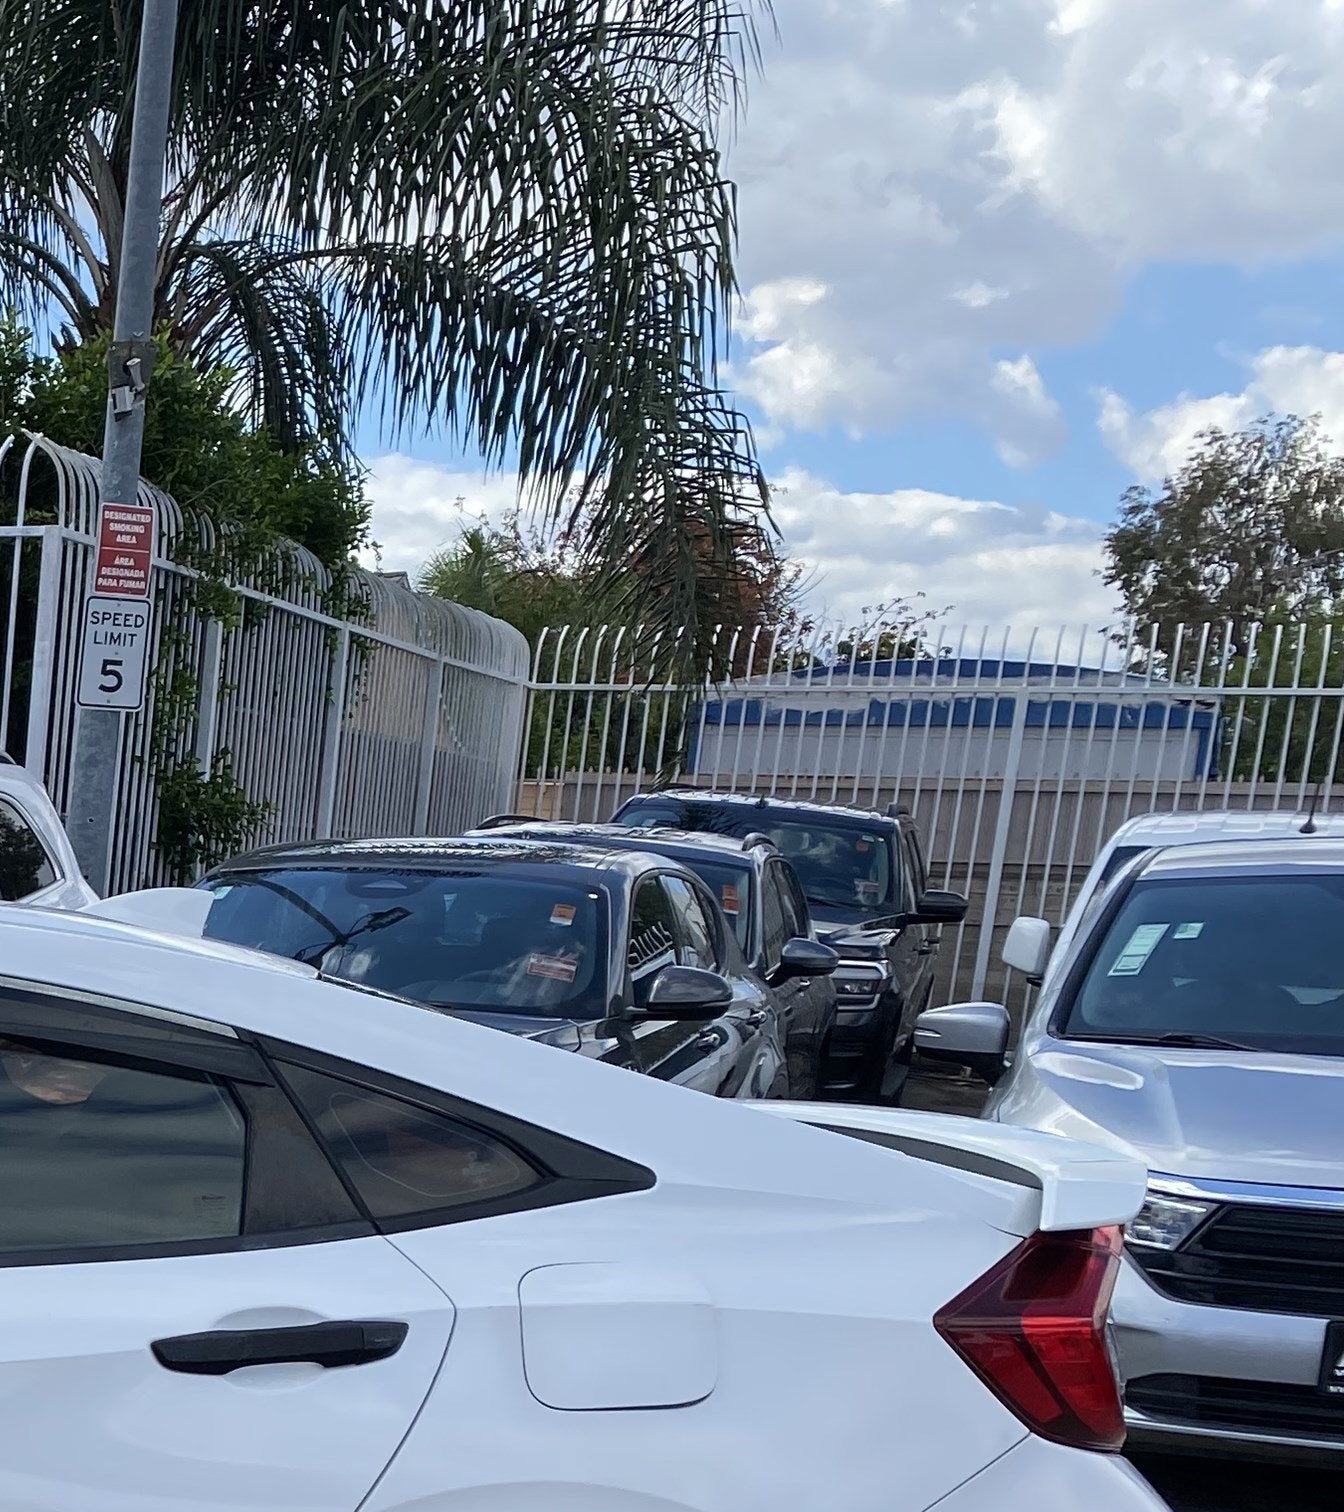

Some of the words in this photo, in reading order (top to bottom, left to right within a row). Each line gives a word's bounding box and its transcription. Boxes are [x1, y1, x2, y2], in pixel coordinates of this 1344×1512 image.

[104, 511, 151, 523] DESIGNATED
[109, 522, 145, 533] SMOKING
[116, 534, 137, 544] AREA
[101, 567, 145, 578] DESIGNADA
[97, 578, 118, 587] PARA
[119, 579, 146, 589] FUMAR
[90, 611, 144, 628] SPEED
[93, 630, 138, 648] LIMIT
[98, 659, 123, 693] 5
